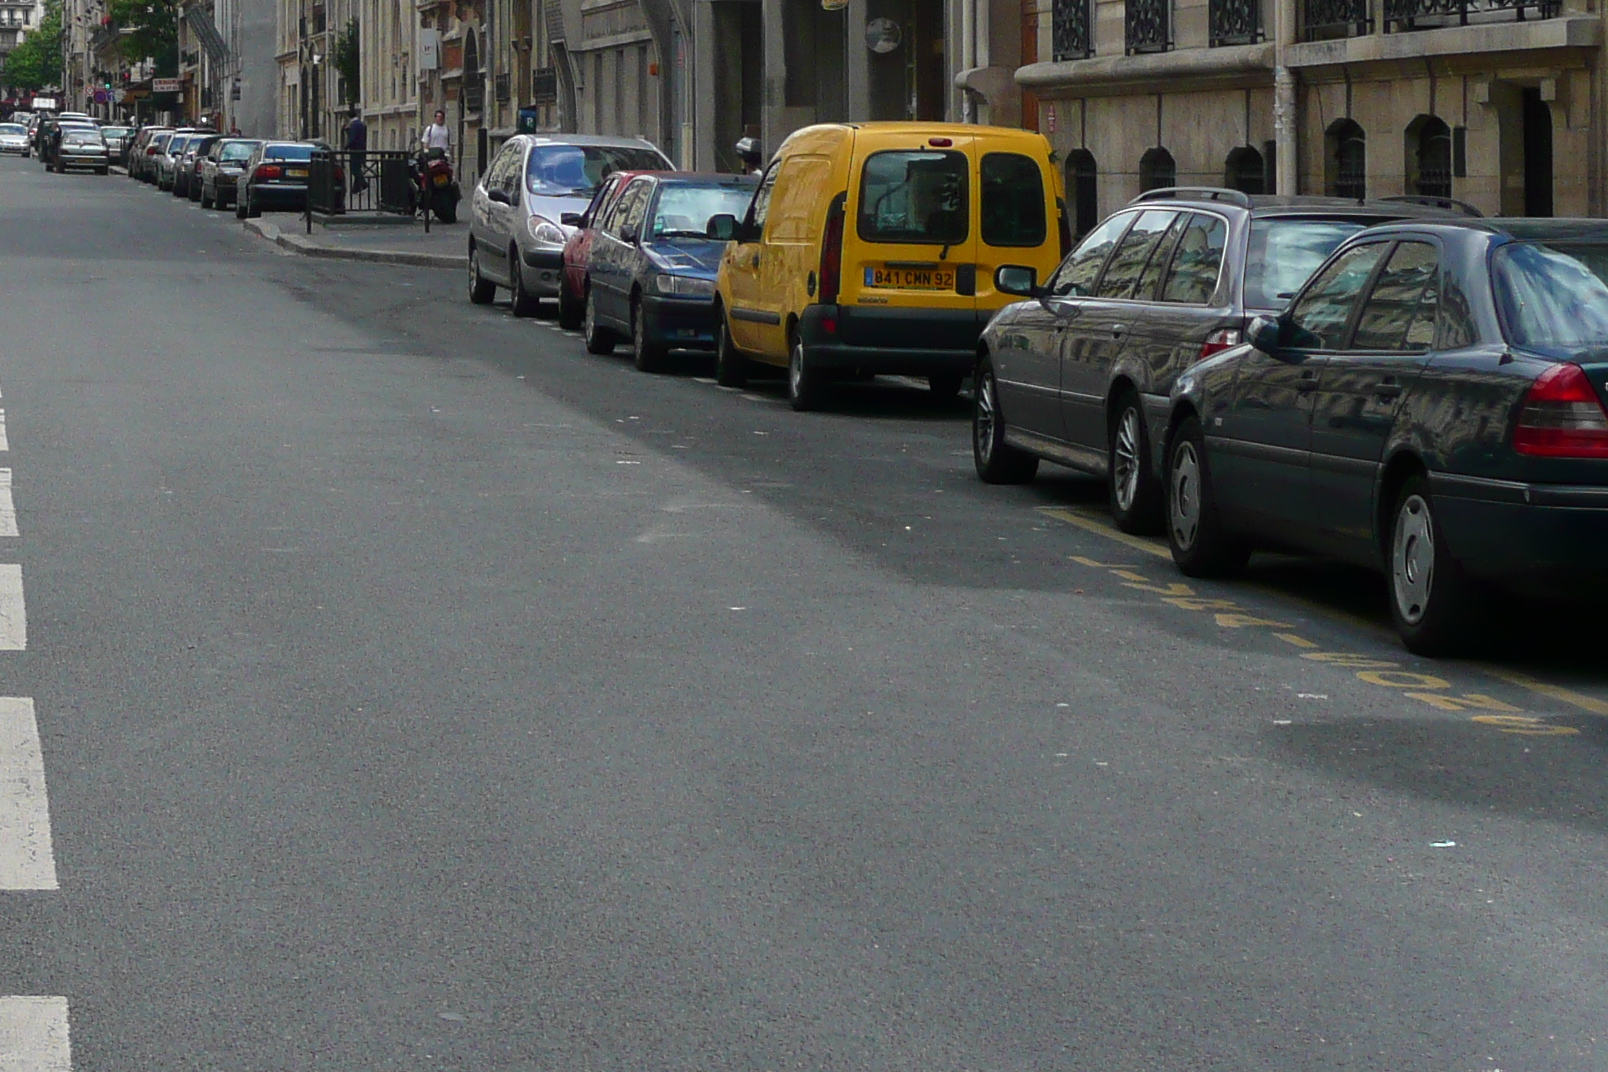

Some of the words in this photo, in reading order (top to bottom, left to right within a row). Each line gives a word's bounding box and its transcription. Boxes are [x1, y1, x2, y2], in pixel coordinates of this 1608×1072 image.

[874, 270, 900, 284] 841
[904, 272, 931, 285] CMN
[934, 272, 952, 286] 92
